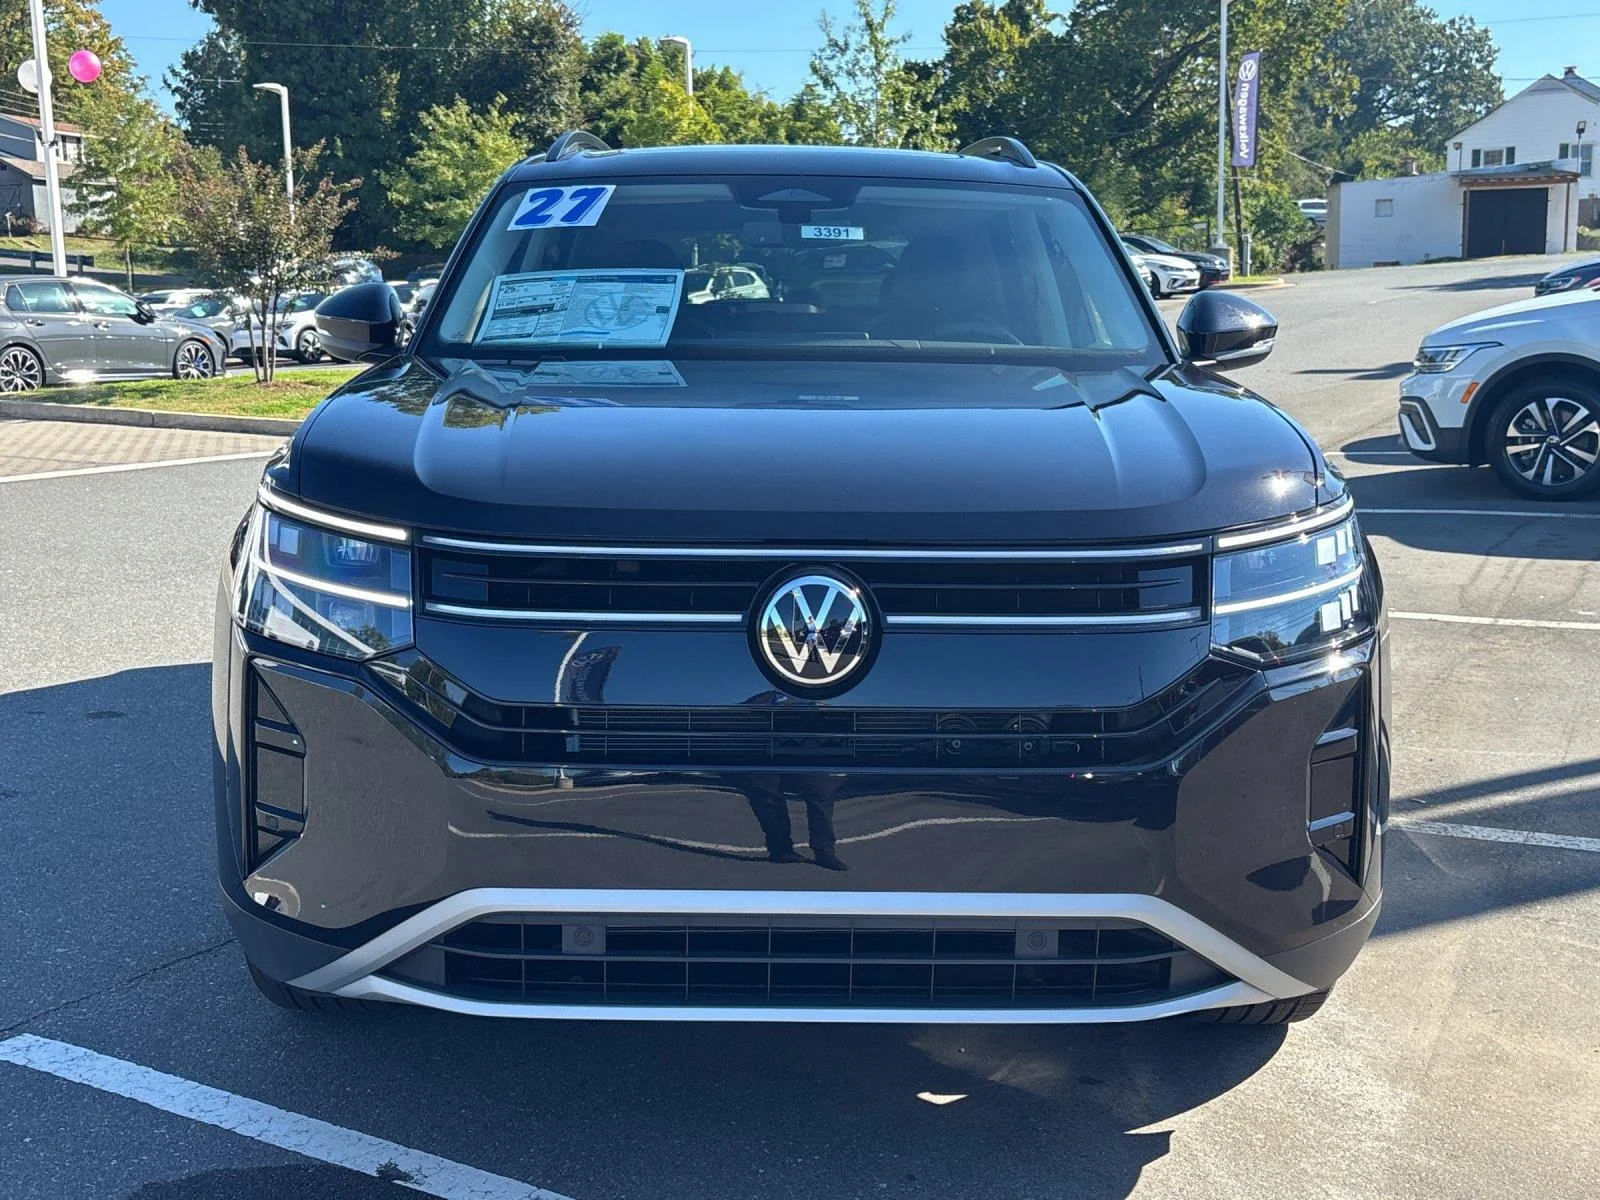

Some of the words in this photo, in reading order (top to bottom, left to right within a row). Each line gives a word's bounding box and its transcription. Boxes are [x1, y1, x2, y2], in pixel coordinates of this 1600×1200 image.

[514, 186, 609, 226] 27
[813, 227, 850, 238] 3391
[764, 579, 863, 680] VW
